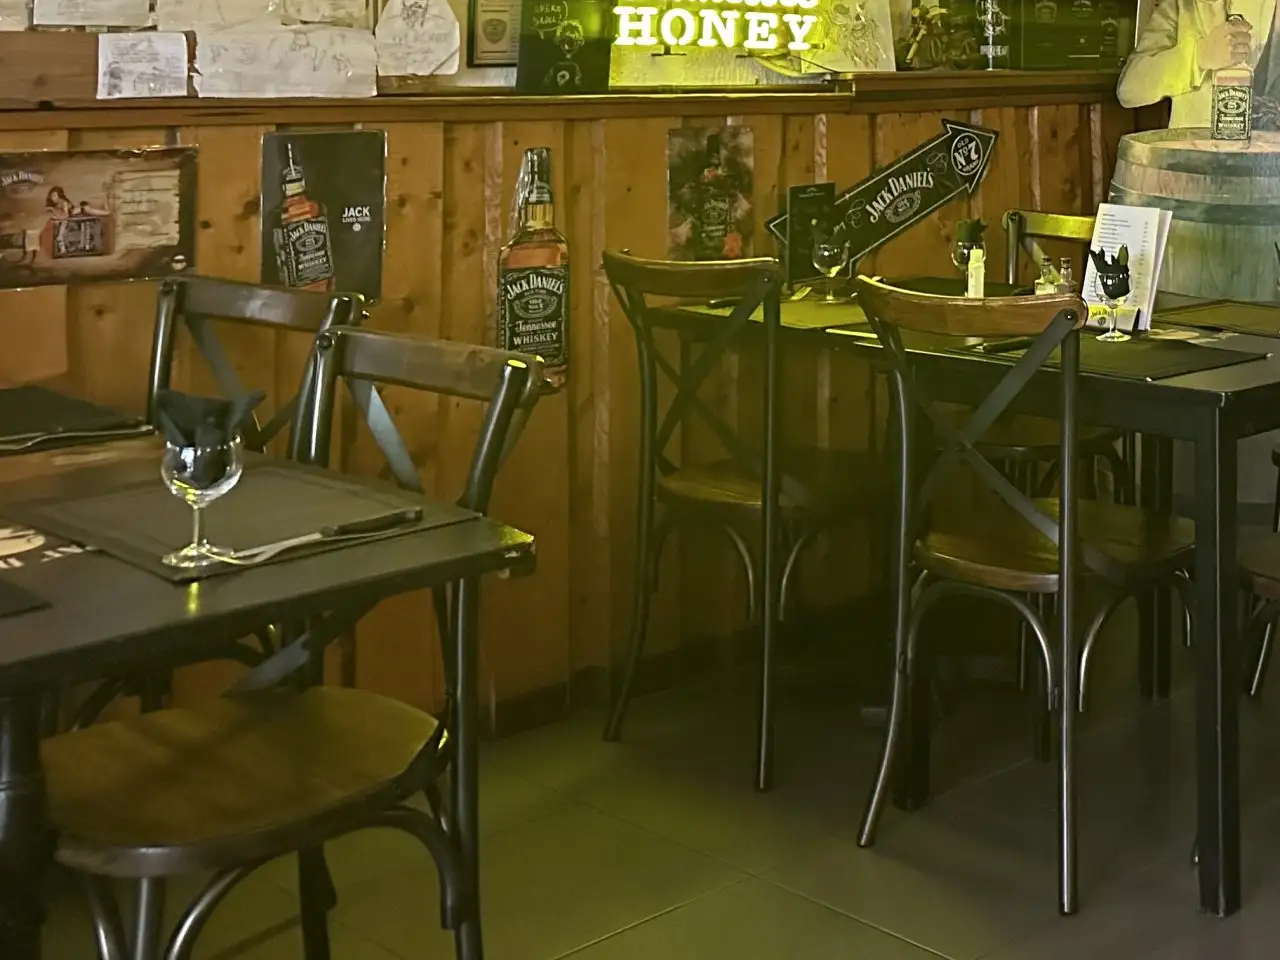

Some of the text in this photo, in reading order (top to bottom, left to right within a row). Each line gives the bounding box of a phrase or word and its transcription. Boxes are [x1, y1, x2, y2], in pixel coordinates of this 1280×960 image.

[614, 5, 818, 50] HONEY
[957, 138, 969, 149] OLD
[865, 168, 934, 224] JACK DANIEL'S
[342, 206, 371, 218] JACK
[289, 226, 304, 242] JACK
[506, 273, 564, 300] JACK DANIEL'S
[515, 320, 557, 333] Tennessee
[513, 331, 558, 345] WHISKEY
